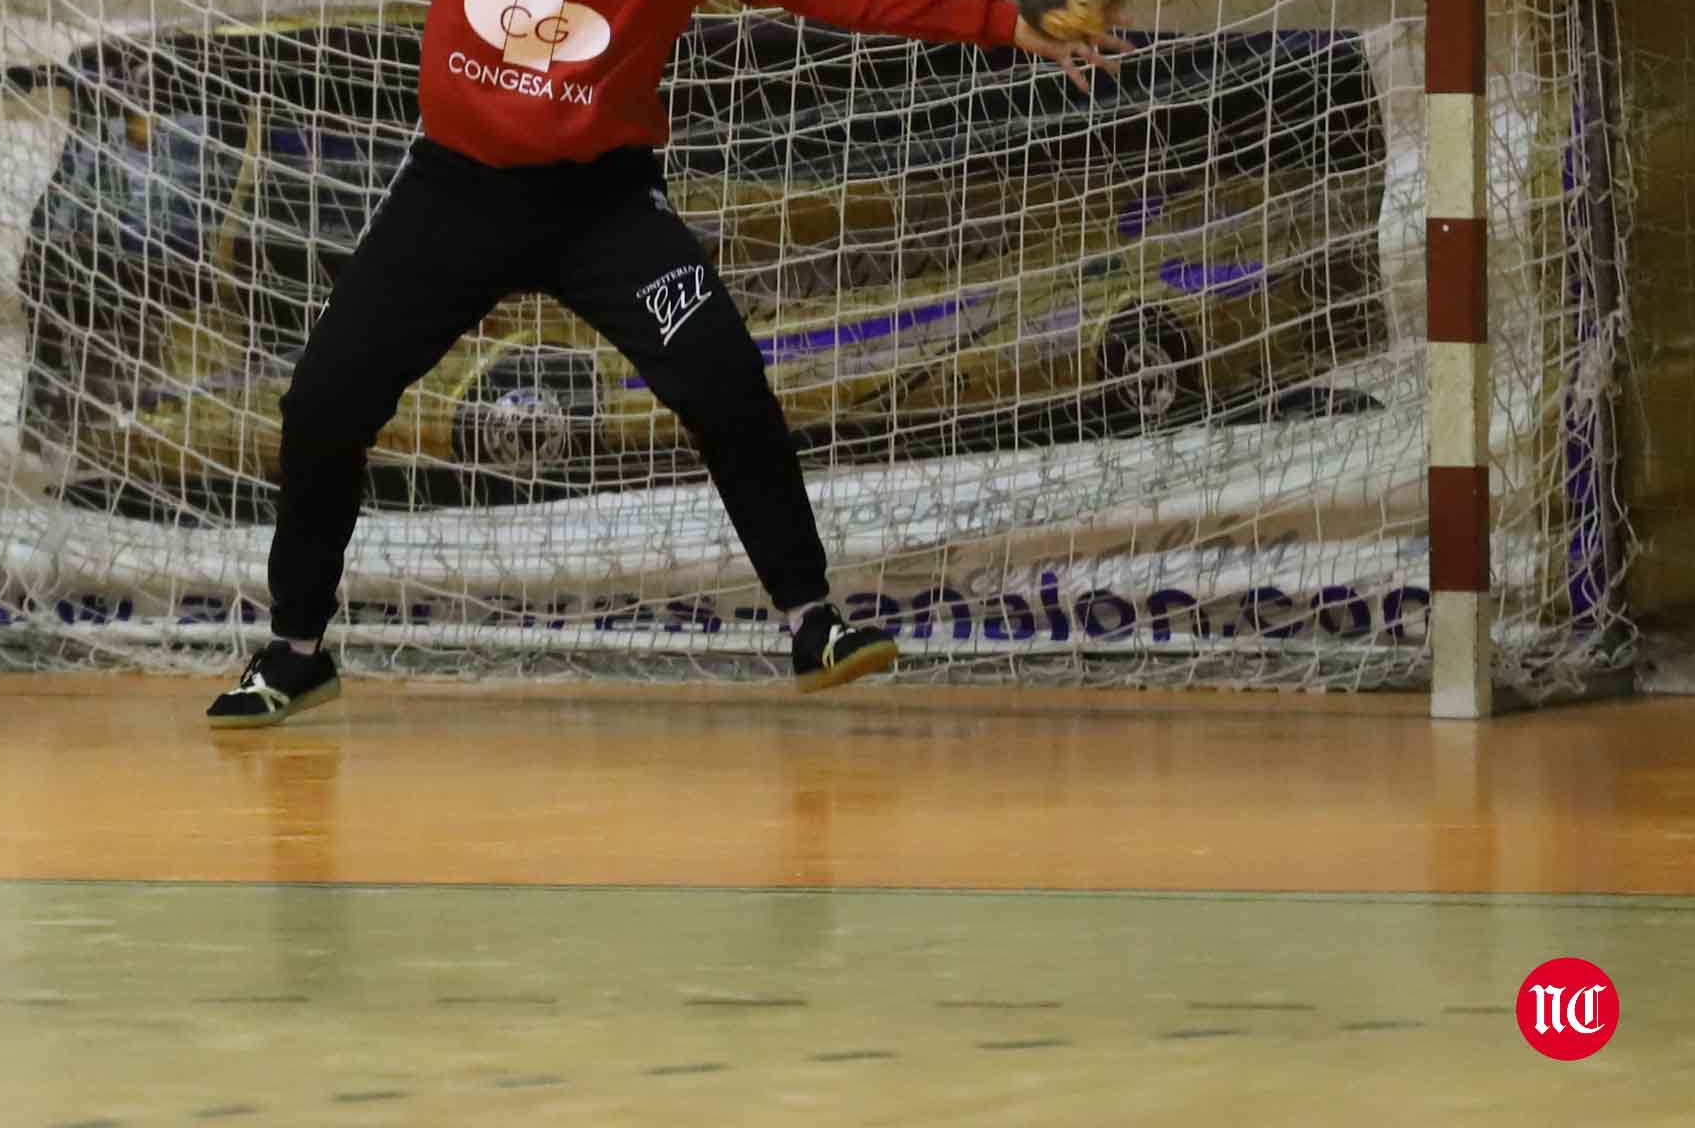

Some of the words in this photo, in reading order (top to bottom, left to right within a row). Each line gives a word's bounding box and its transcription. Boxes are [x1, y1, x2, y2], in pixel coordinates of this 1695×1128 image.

[500, 5, 569, 44] CG
[448, 50, 554, 100] CONGESA
[559, 81, 594, 105] XXI
[646, 264, 708, 336] Gil
